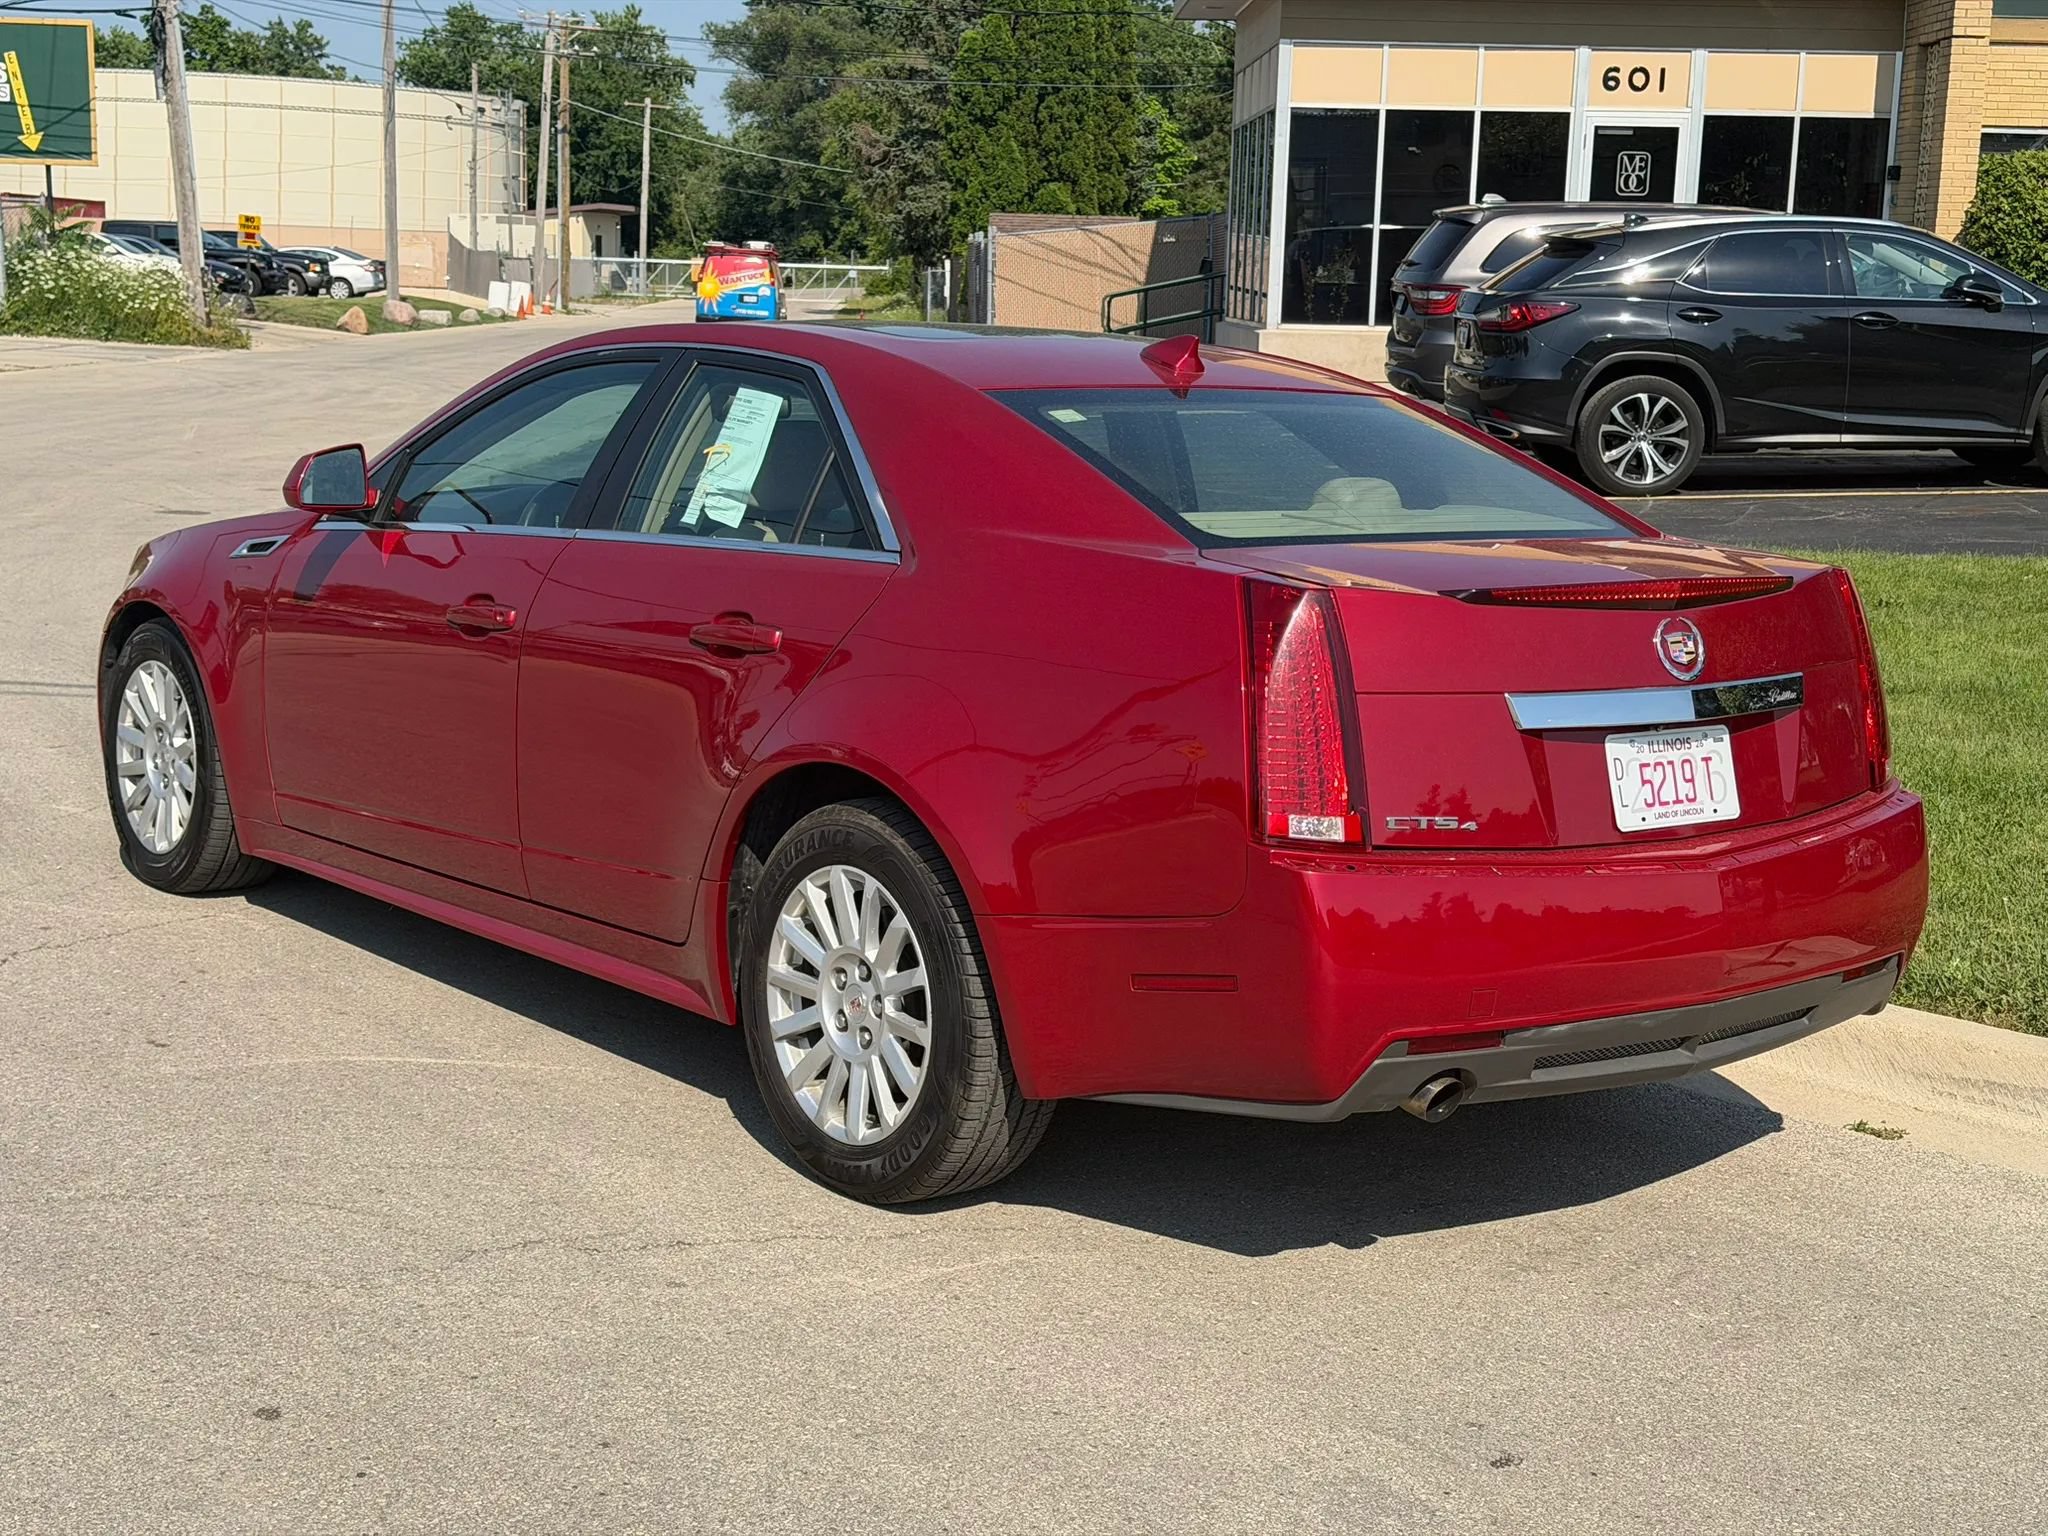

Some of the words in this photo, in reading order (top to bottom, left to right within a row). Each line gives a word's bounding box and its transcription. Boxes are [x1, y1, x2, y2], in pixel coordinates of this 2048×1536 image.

[1602, 66, 1666, 93] 601
[718, 271, 766, 286] WANTUCK
[1647, 737, 1692, 754] ILLINOIS
[1638, 758, 1698, 808] 5219
[1654, 812, 1670, 820] LAND
[1679, 807, 1705, 817] LINCOLN
